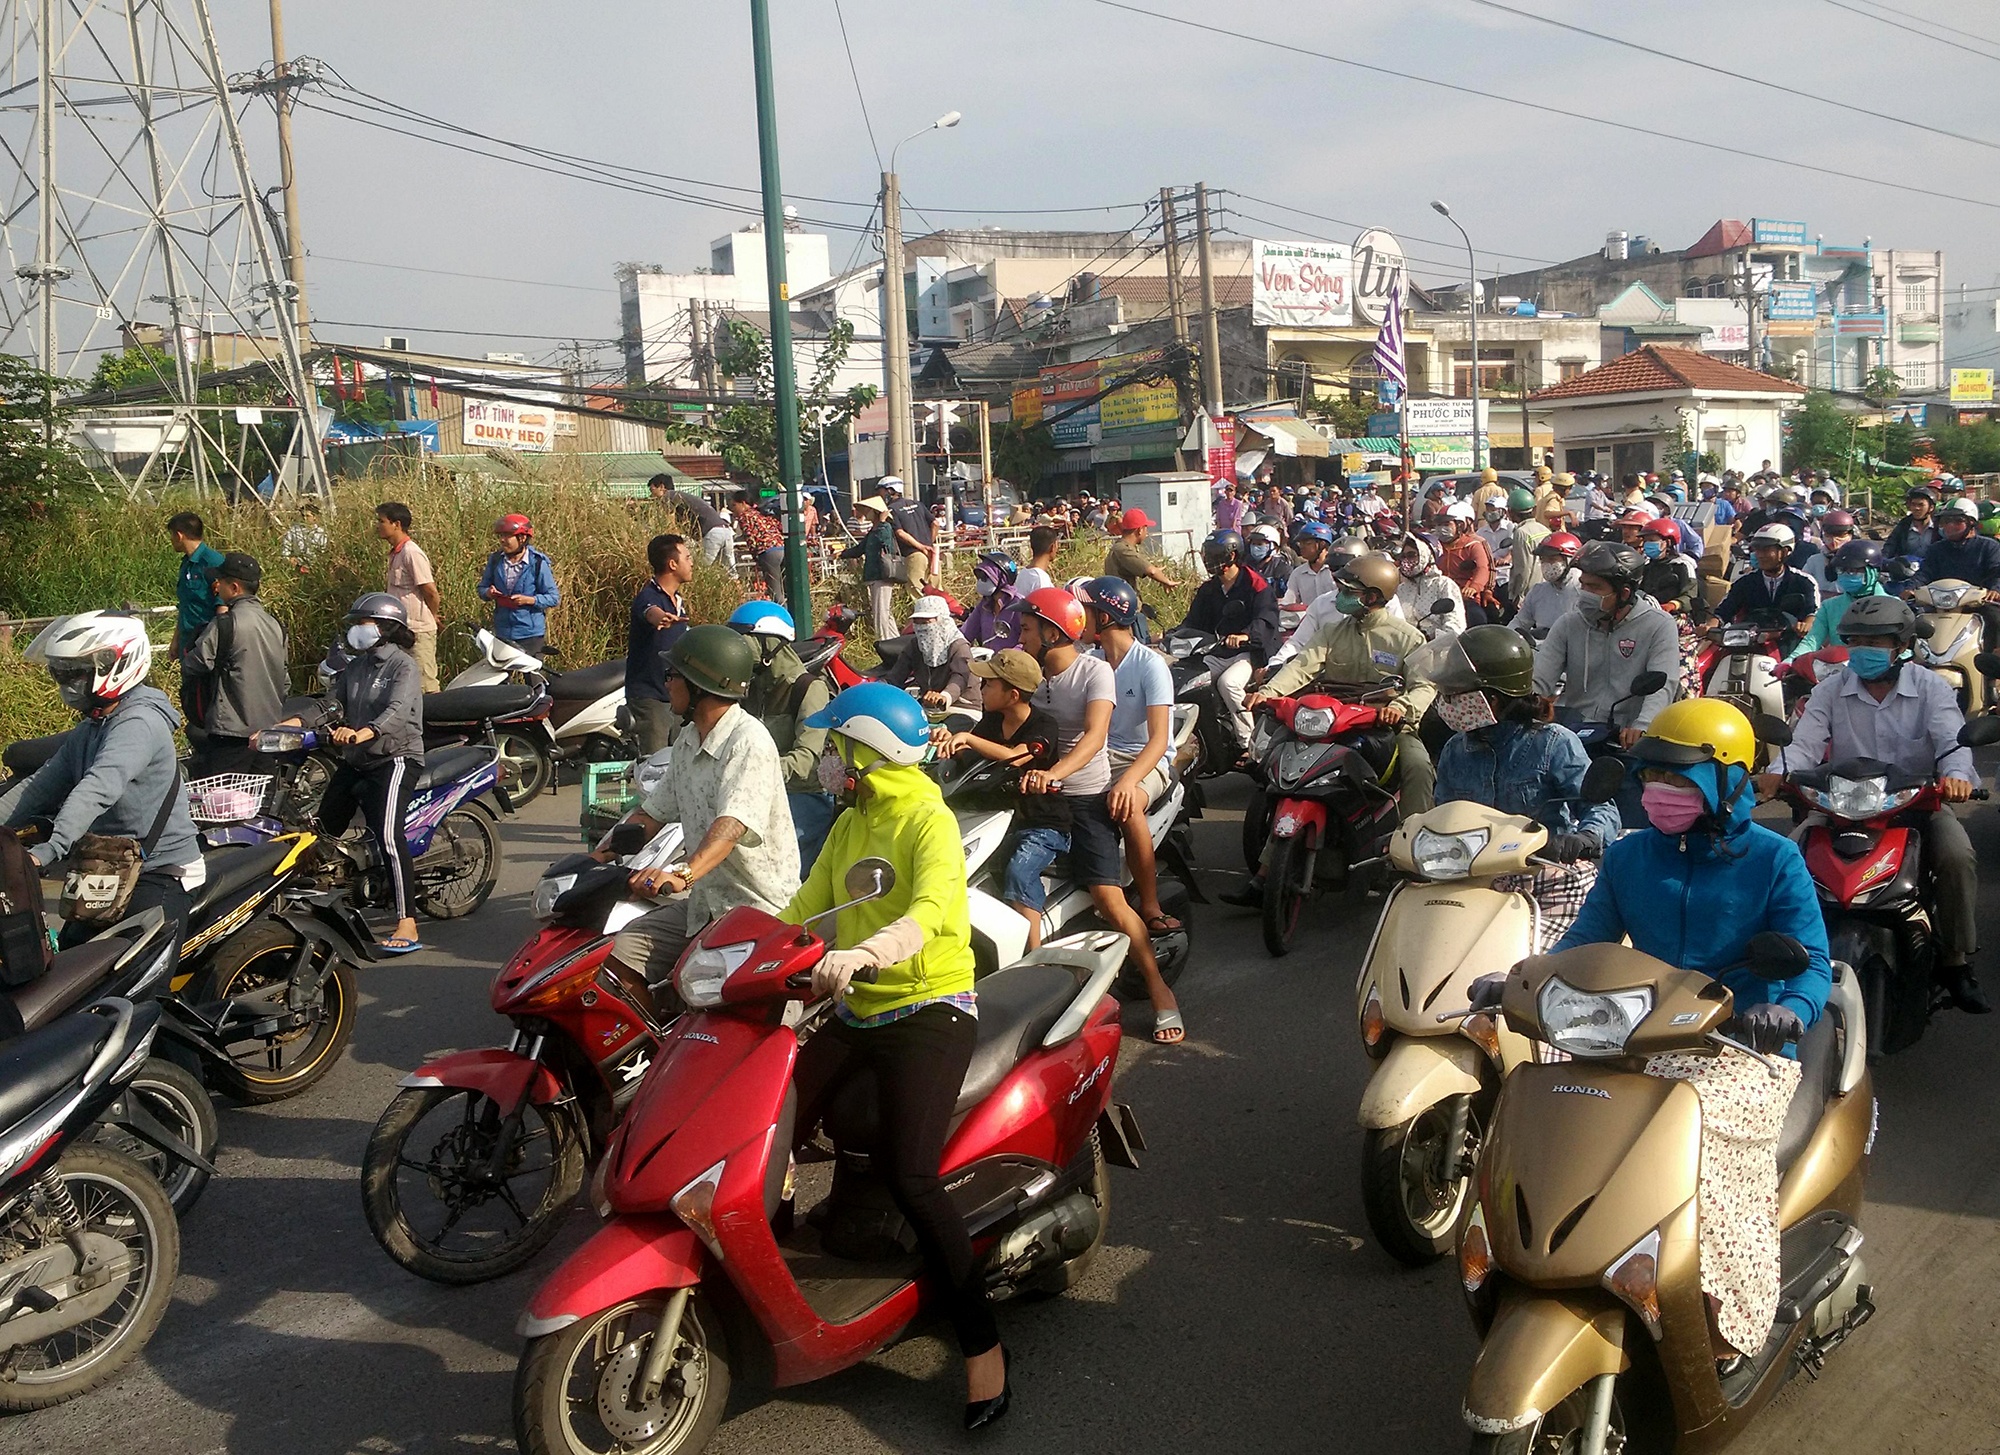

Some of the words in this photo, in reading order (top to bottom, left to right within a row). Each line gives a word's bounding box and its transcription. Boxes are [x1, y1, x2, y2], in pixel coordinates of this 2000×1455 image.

[1262, 261, 1295, 291] Ven
[1299, 263, 1344, 304] Sông
[1720, 327, 1744, 344] 485
[492, 404, 514, 423] TÌNH
[1412, 407, 1450, 418] PHƯỚC
[474, 424, 512, 440] QUAY
[518, 430, 544, 443] HEO
[1424, 899, 1466, 908] HONDA
[180, 890, 261, 954] EXCITER
[1552, 1086, 1612, 1100] HONDA
